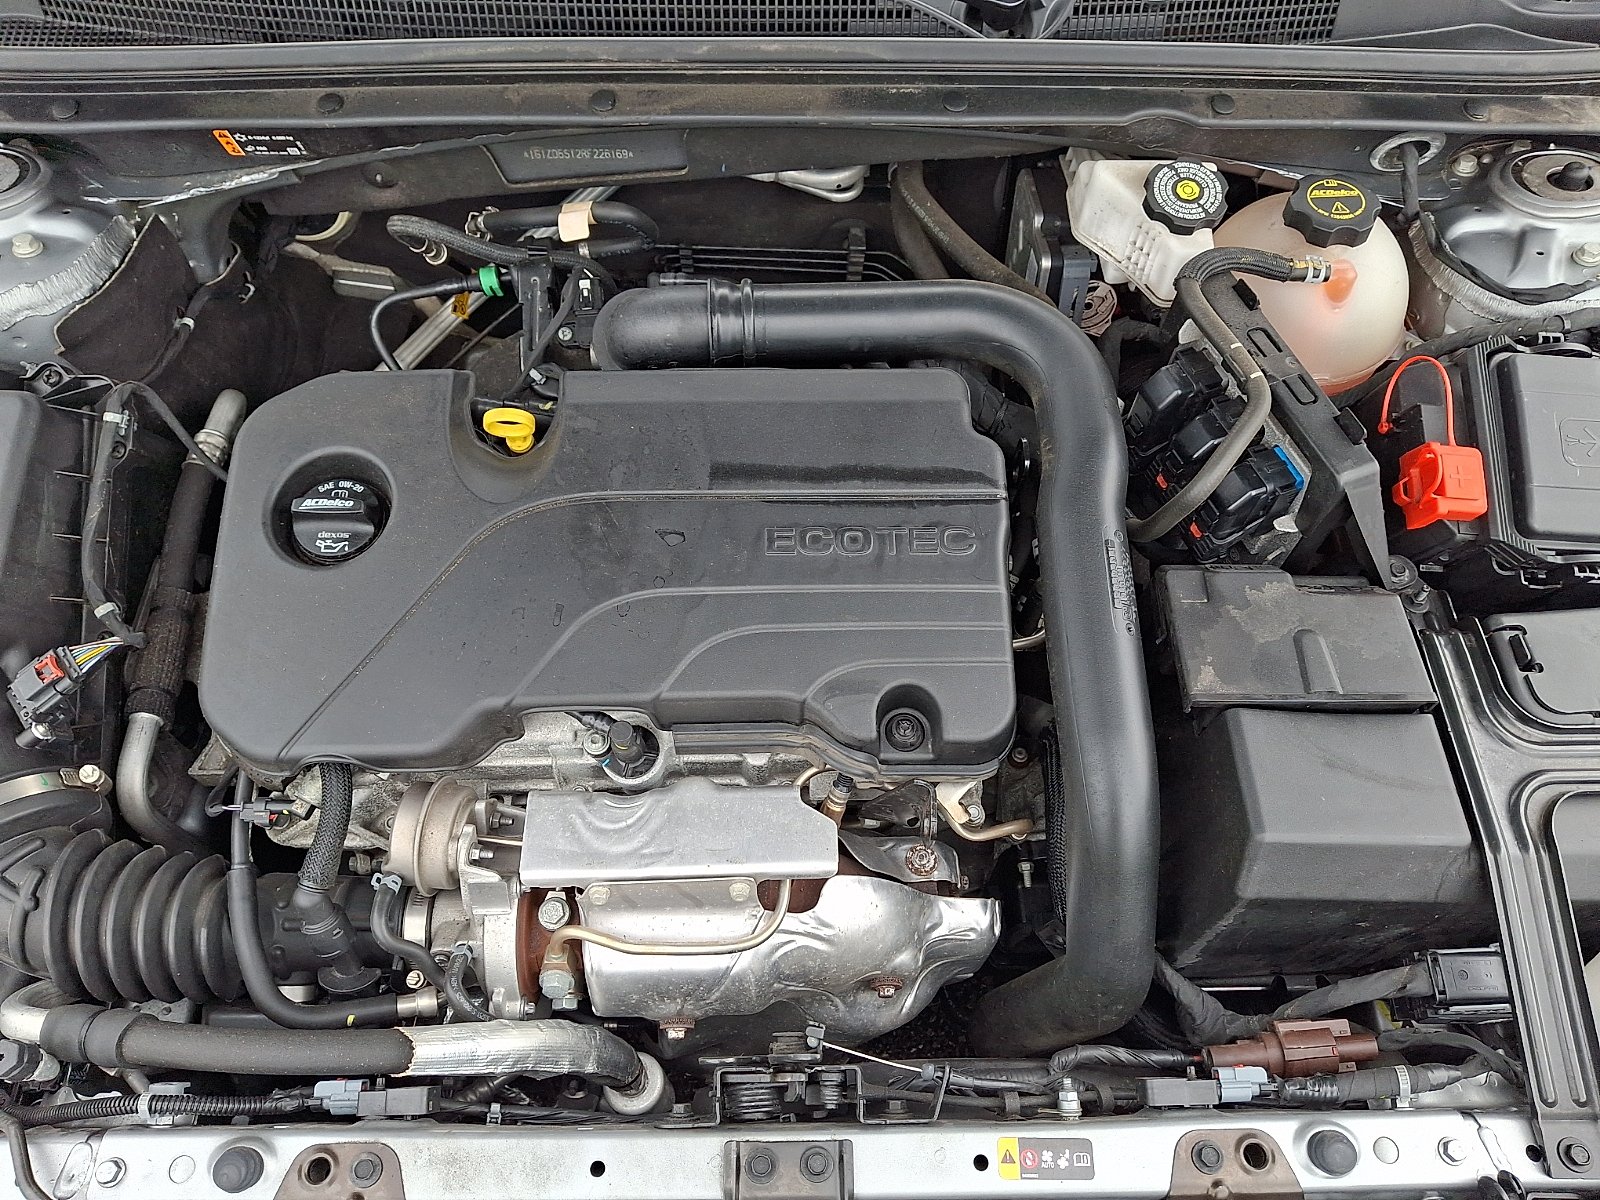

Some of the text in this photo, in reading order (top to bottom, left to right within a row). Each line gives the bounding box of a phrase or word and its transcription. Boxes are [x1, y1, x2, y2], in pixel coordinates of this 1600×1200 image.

[318, 482, 335, 493] SAE
[300, 498, 354, 507] ACDelco
[318, 531, 351, 539] dexos
[764, 525, 977, 556] ECOTEC
[1041, 1161, 1055, 1169] AUTO
